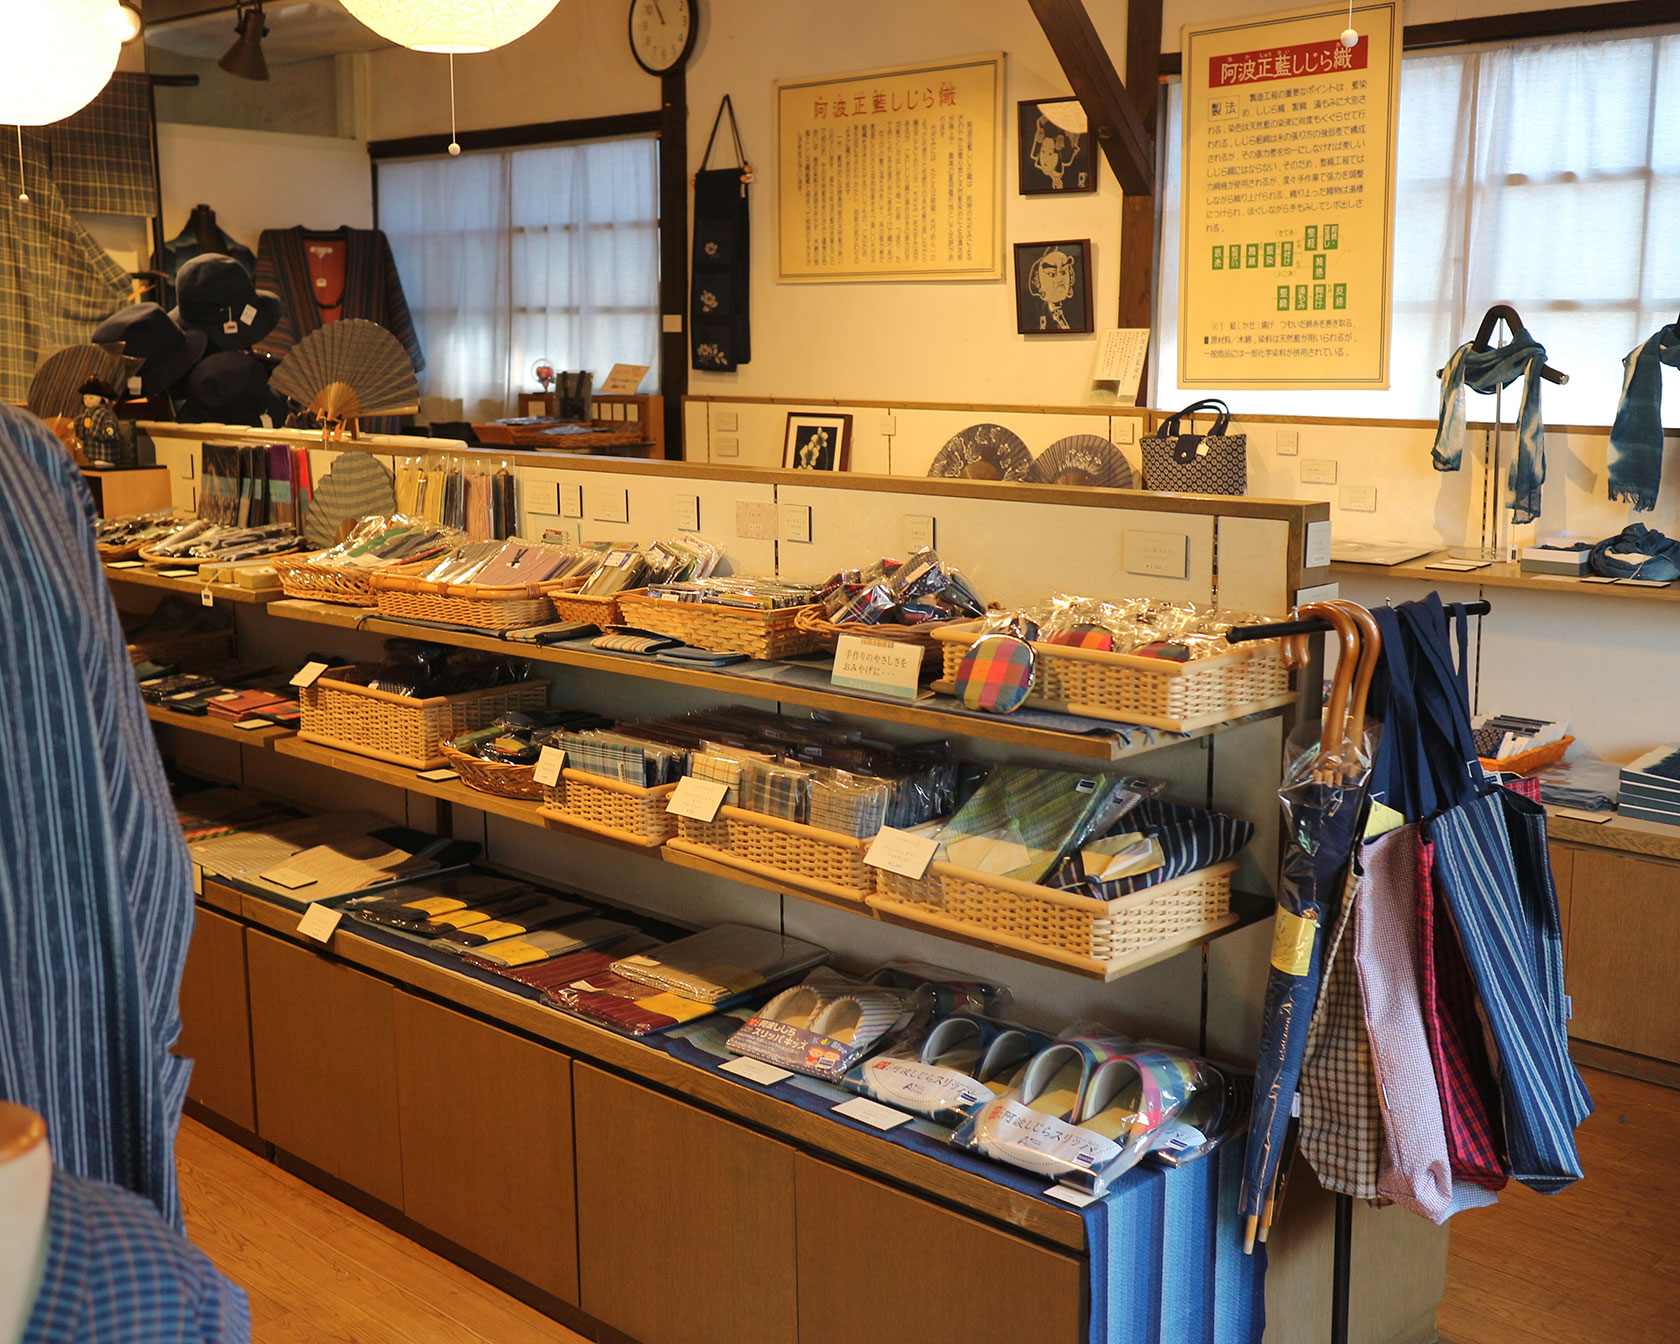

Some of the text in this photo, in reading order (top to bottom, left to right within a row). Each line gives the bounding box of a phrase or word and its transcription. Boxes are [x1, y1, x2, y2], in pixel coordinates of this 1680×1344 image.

[1221, 47, 1352, 84] 阿波正藍しじら織
[814, 85, 957, 120] 阿波正藍しじら織
[1212, 101, 1236, 117] 製法
[846, 649, 908, 669] 手作りのやさしさを
[752, 1027, 784, 1043] スリッパ
[758, 1019, 797, 1037] 阿波しじら
[1002, 1110, 1098, 1153] 阿波しじらスリッパ
